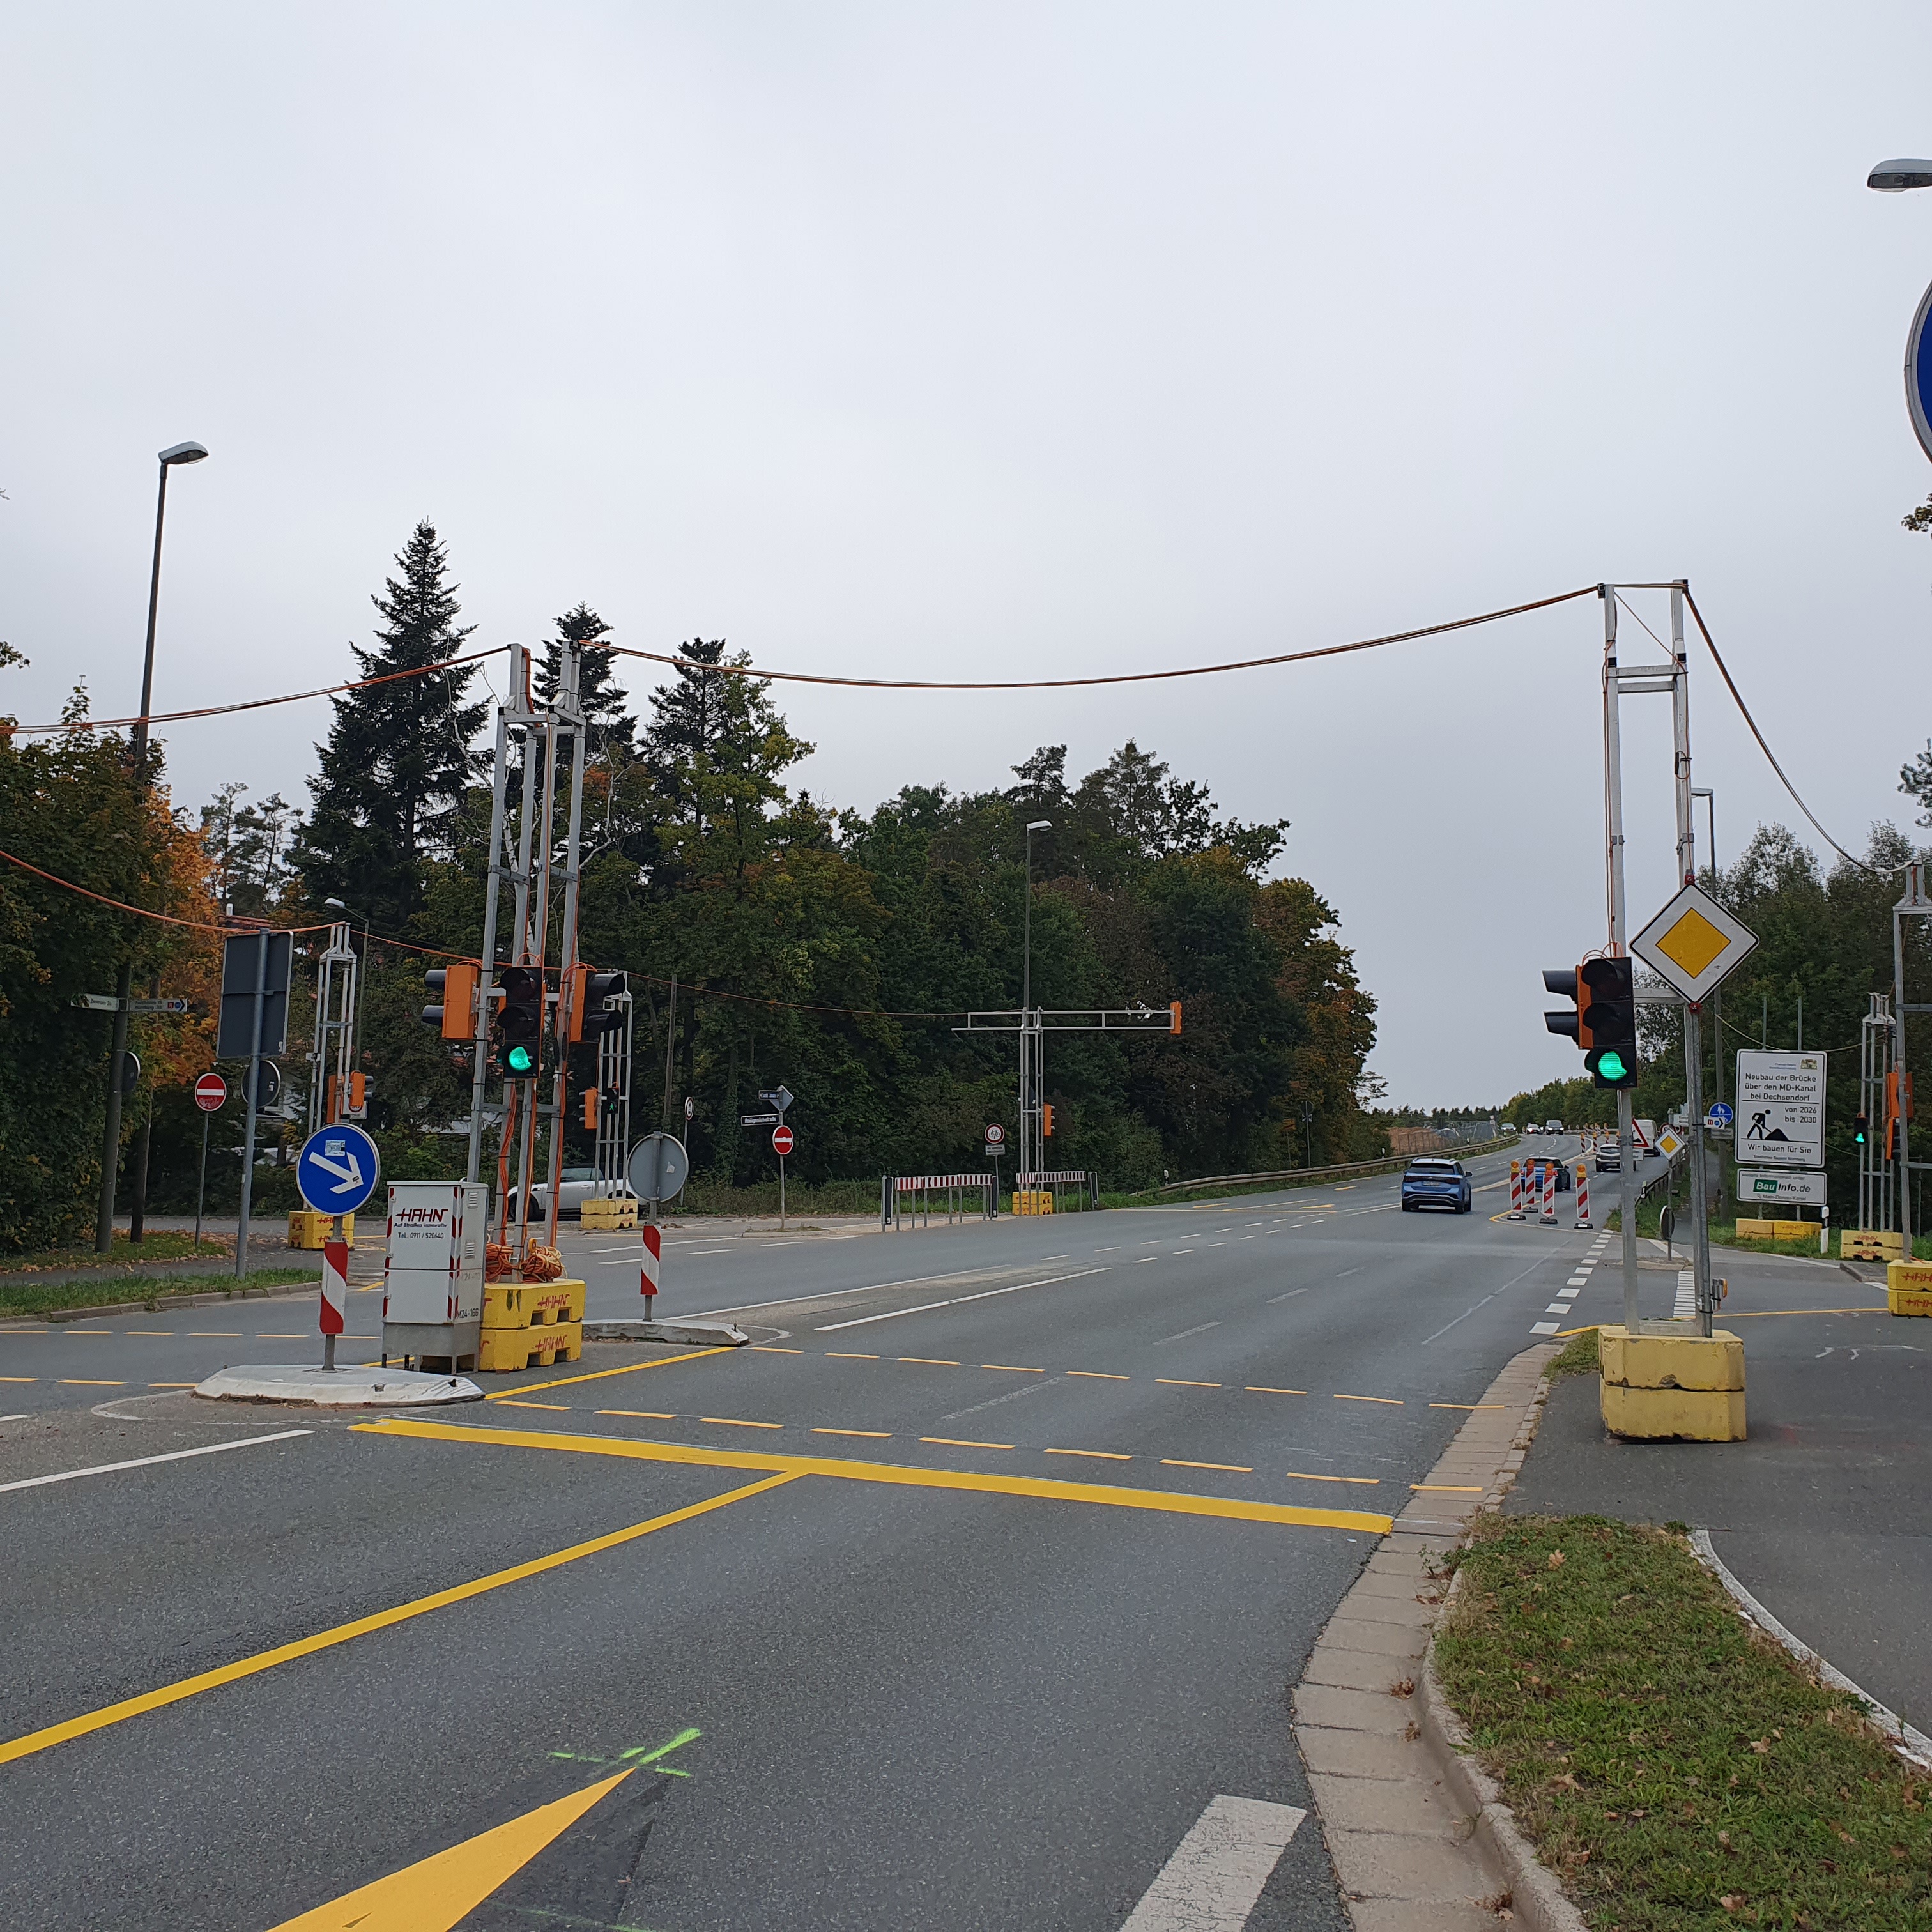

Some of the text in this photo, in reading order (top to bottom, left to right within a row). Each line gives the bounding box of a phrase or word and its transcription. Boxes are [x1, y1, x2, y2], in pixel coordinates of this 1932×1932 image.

[395, 1208, 448, 1222] HAHN
[537, 1293, 570, 1309] HAHN
[535, 1334, 568, 1352] HAHN
